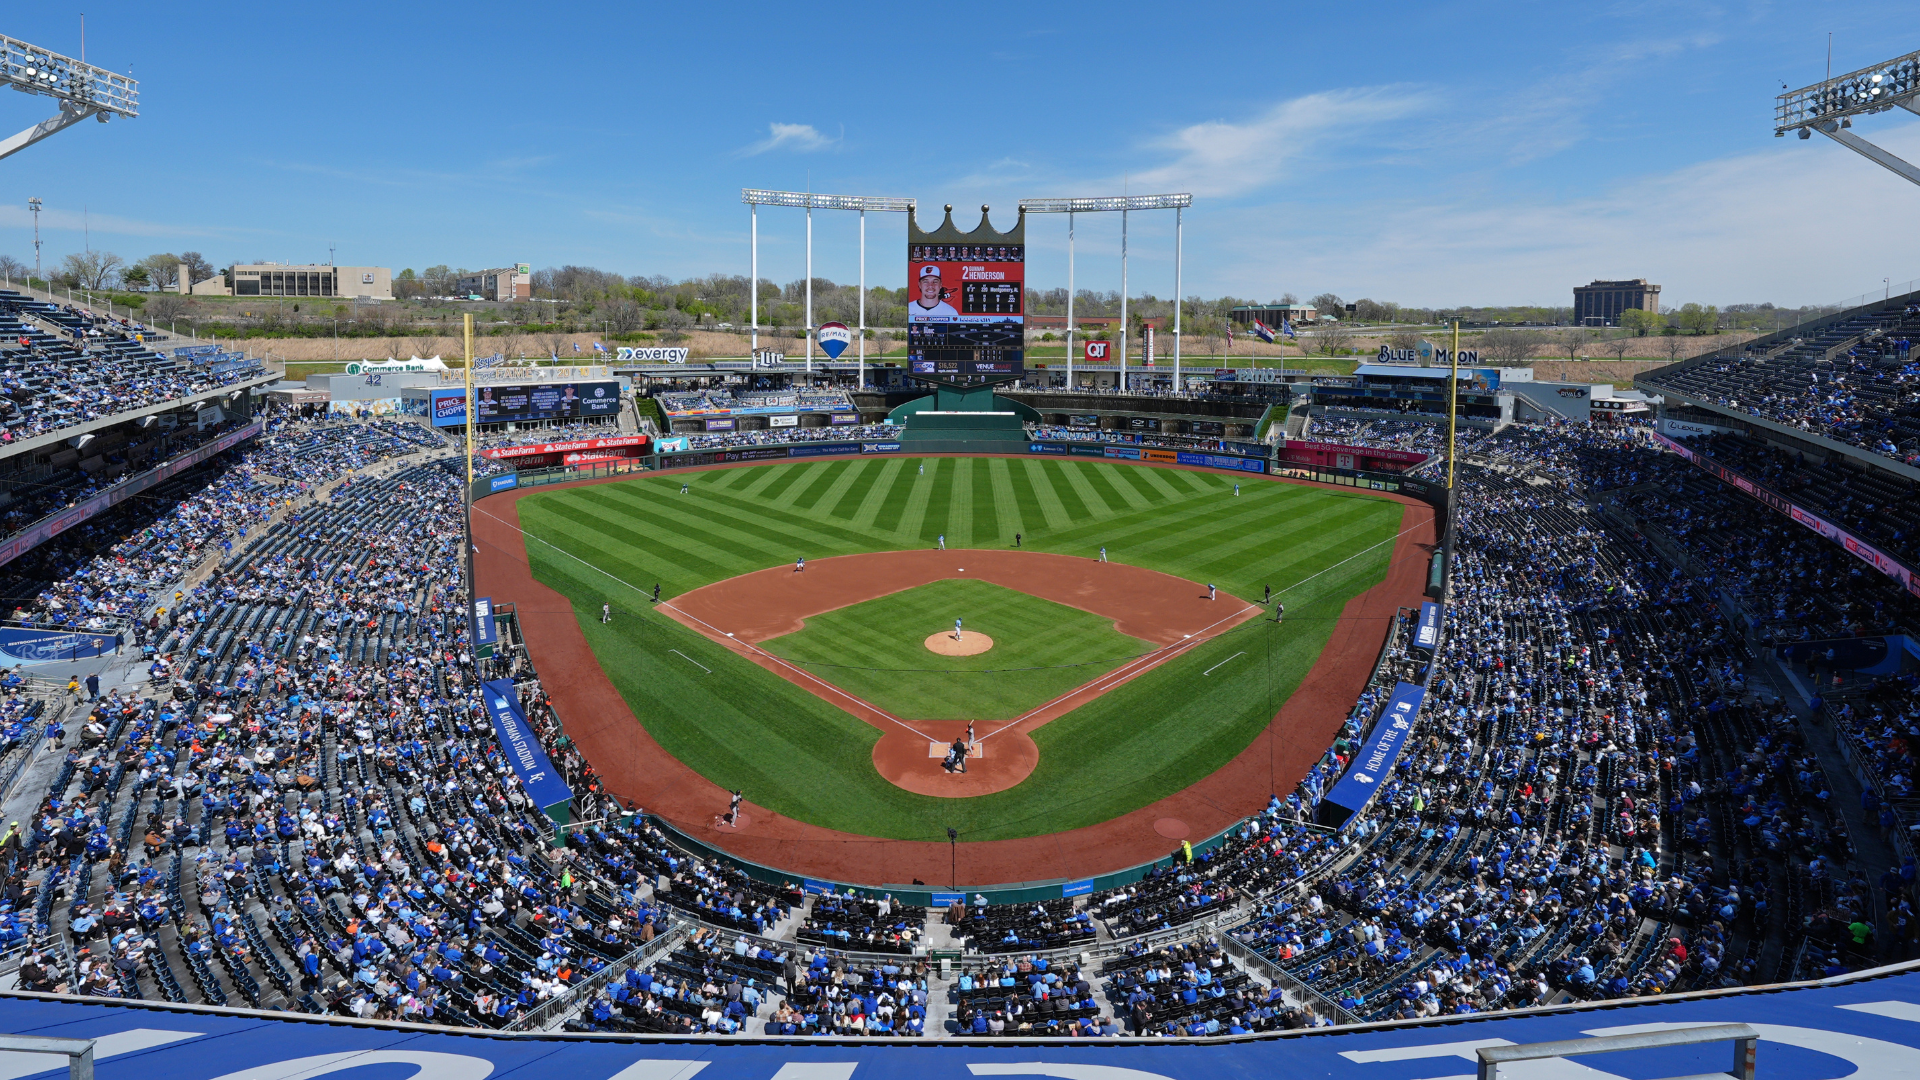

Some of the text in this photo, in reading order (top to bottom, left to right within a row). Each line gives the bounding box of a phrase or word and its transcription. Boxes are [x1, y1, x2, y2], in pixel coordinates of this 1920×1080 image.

[962, 266, 969, 280] 2
[969, 272, 1005, 280] HENDERSON
[635, 348, 687, 363] evergy
[1087, 342, 1107, 358] QT
[1377, 344, 1416, 363] BLUE
[473, 352, 504, 370] Royals
[760, 351, 784, 367] Lite
[362, 364, 424, 373] Commerce Bank
[495, 368, 534, 379] FAME
[558, 368, 570, 377] 20
[579, 367, 590, 376] 10
[365, 374, 382, 385] 42
[1238, 370, 1275, 382] PATIO
[437, 398, 461, 408] PRICE
[437, 403, 467, 418] CHOPPE
[1677, 424, 1704, 433] LEXUS
[1051, 430, 1096, 440] FOUNTAIN
[1099, 433, 1124, 442] DECK
[581, 448, 626, 460] State Farm
[725, 452, 739, 461] Pay
[1305, 442, 1320, 450] Best
[1332, 446, 1364, 455] coverage
[1387, 452, 1408, 460] game
[519, 455, 544, 465] Farm
[498, 711, 521, 742] KAUFFMAN
[513, 737, 536, 771] STADIUM
[1365, 750, 1385, 773] HOME
[1384, 729, 1399, 745] THE
